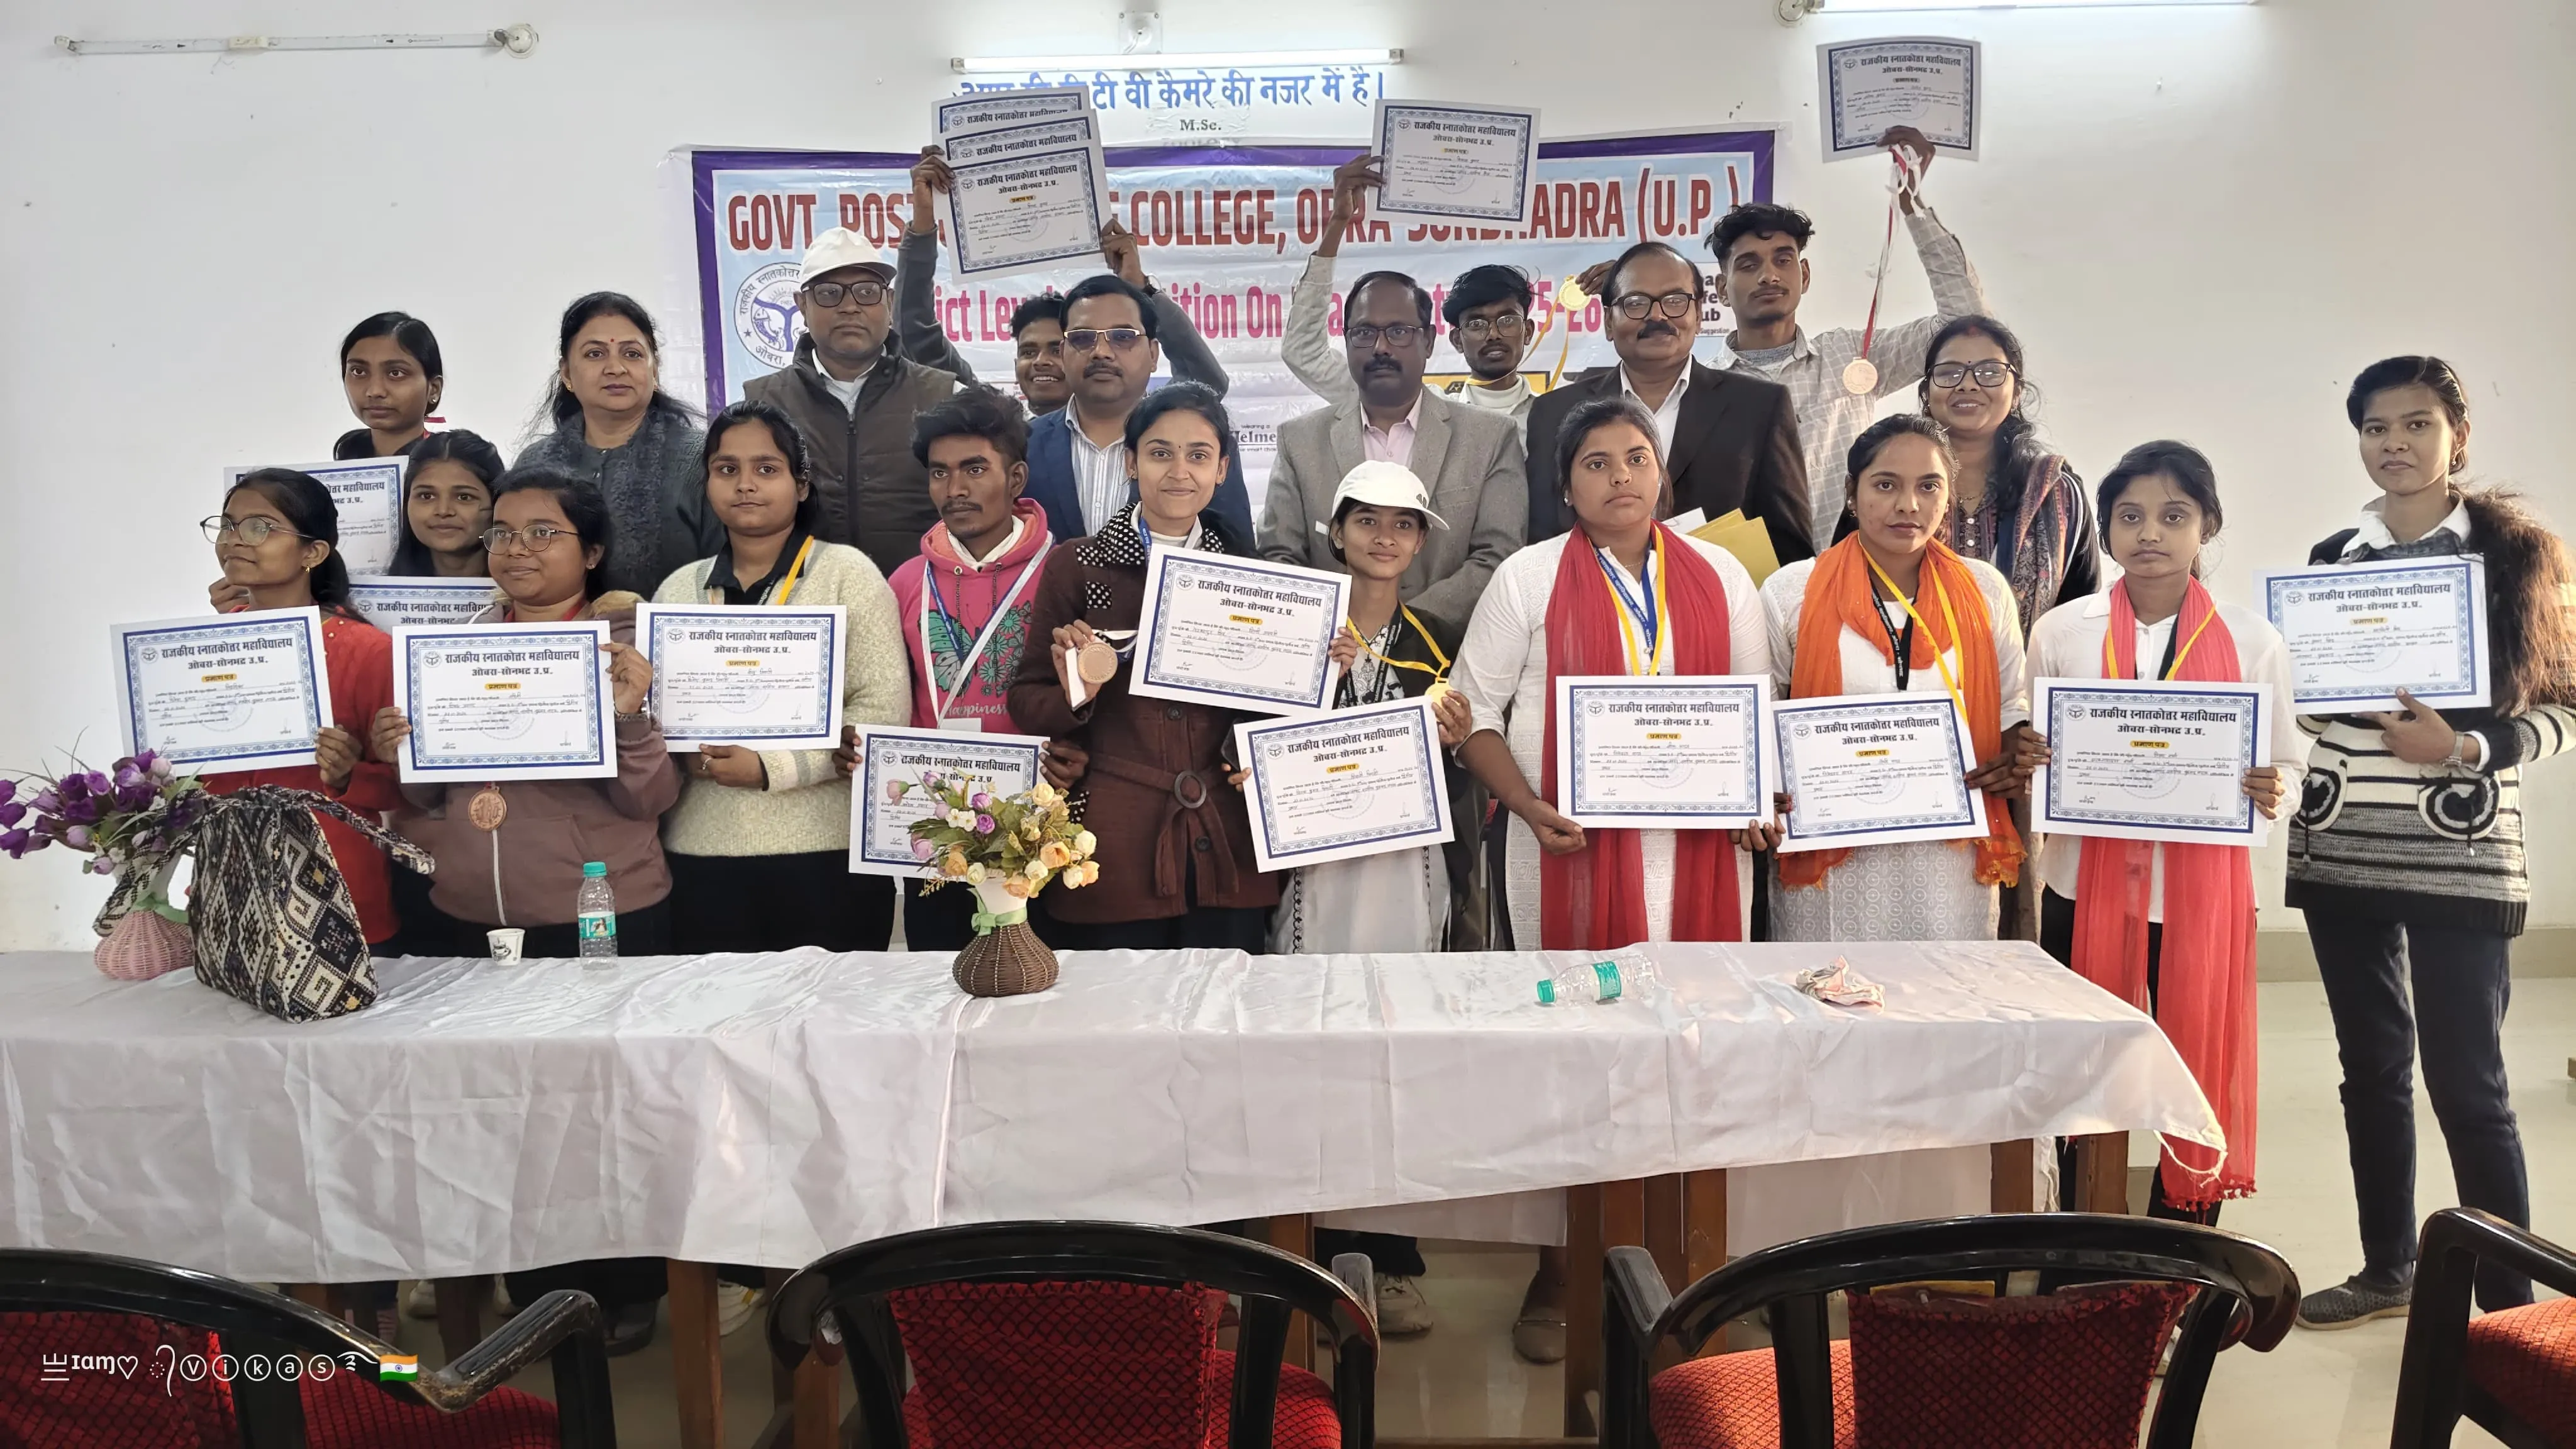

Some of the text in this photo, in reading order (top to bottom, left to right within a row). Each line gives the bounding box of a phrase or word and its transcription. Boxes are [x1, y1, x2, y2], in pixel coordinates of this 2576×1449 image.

[1092, 70, 1118, 109] टी
[1125, 70, 1153, 109] वी
[1156, 69, 1216, 109] कैमरे
[1222, 69, 1255, 106] की
[1260, 75, 1315, 105] नजर
[1321, 65, 1345, 103] में
[967, 112, 992, 124] राजकीय
[1180, 119, 1221, 131] M.Sc.
[977, 143, 1002, 156] राजकीय
[729, 193, 816, 251] GOVT
[839, 193, 915, 250] POS
[1130, 188, 1287, 253] COLLEGE,
[1638, 166, 1738, 243] (U.P)
[740, 283, 757, 315] राजकीय
[1246, 286, 1282, 338] On
[1234, 431, 1276, 443] elme
[1197, 579, 1230, 594] राजकीय
[1275, 588, 1323, 608] महाविद्यालय
[2308, 589, 2345, 602] राजकीय
[2396, 582, 2451, 596] महाविद्यालय
[377, 601, 408, 612] राजकीय
[689, 630, 723, 641] राजकीय
[769, 630, 817, 641] महाविद्यालय
[161, 644, 194, 659] राजकीय
[243, 637, 293, 652] महाविद्यालय
[445, 651, 479, 664] राजकीय
[528, 648, 580, 662] महाविद्यालय
[1609, 702, 1643, 713] राजकीय
[1690, 701, 1740, 713] महाविद्यालय
[2089, 706, 2127, 719] राजकीय
[2180, 708, 2237, 723] महाविद्यालय
[1814, 721, 1848, 735] राजकीय
[1894, 716, 1940, 730] महाविद्यालय
[1287, 738, 1319, 753] राजकीय
[1363, 726, 1410, 743] महाविद्यालय
[975, 759, 1021, 772] महाविद्यालय
